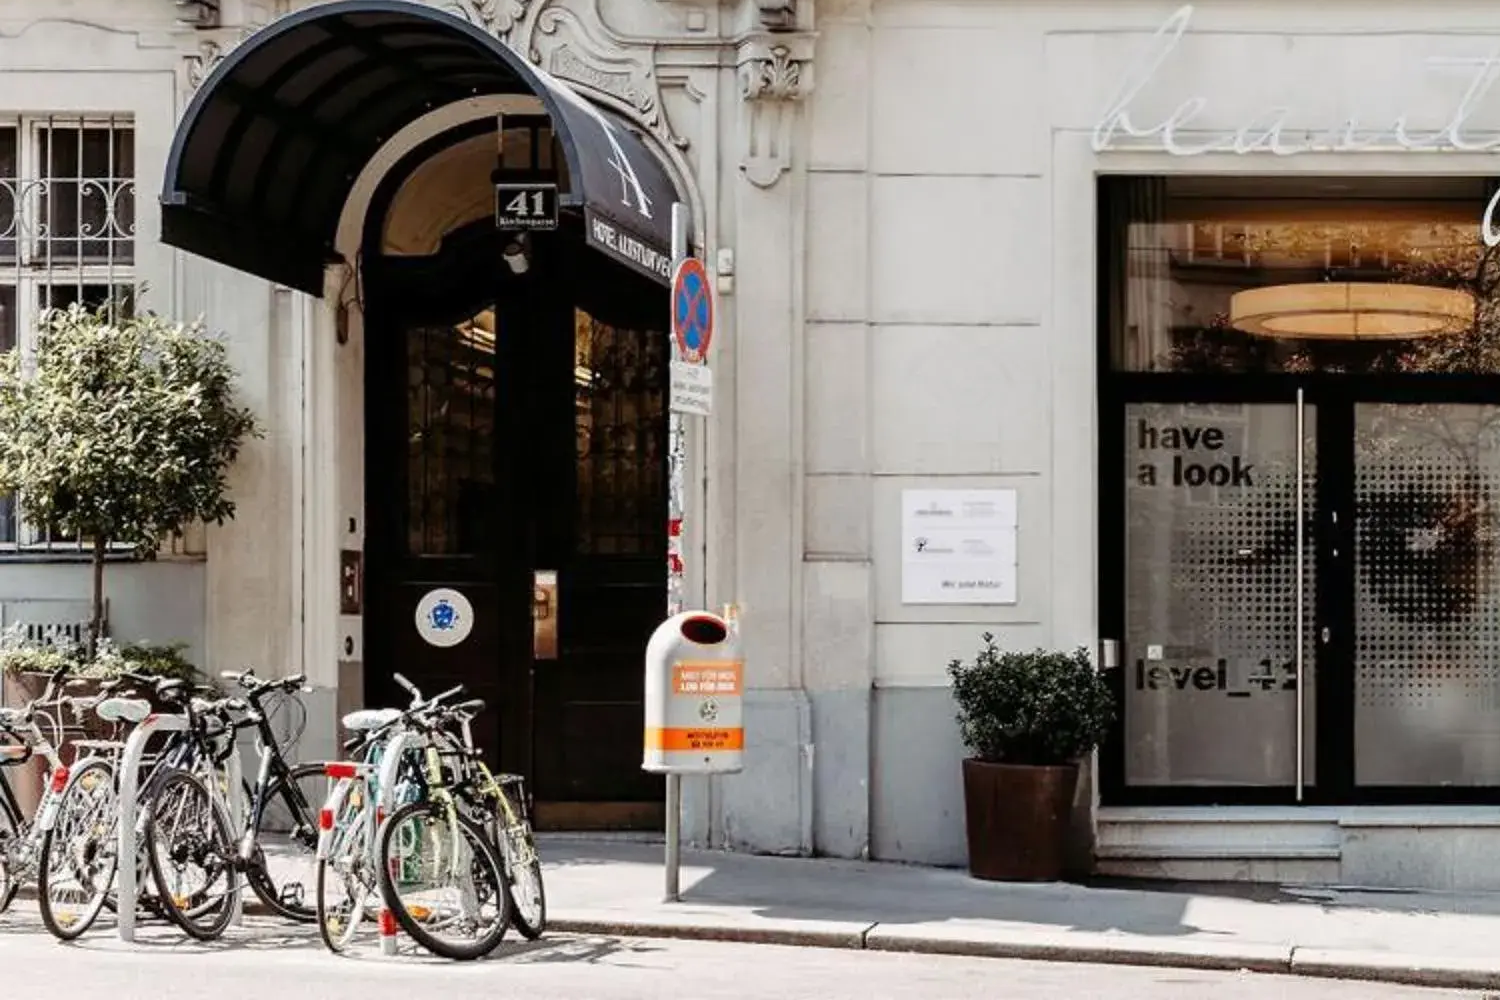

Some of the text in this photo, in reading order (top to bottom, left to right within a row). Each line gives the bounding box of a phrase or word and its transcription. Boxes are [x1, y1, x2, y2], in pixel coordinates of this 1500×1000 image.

[505, 190, 545, 216] 41
[1138, 418, 1224, 449] have
[1137, 455, 1253, 487] a look
